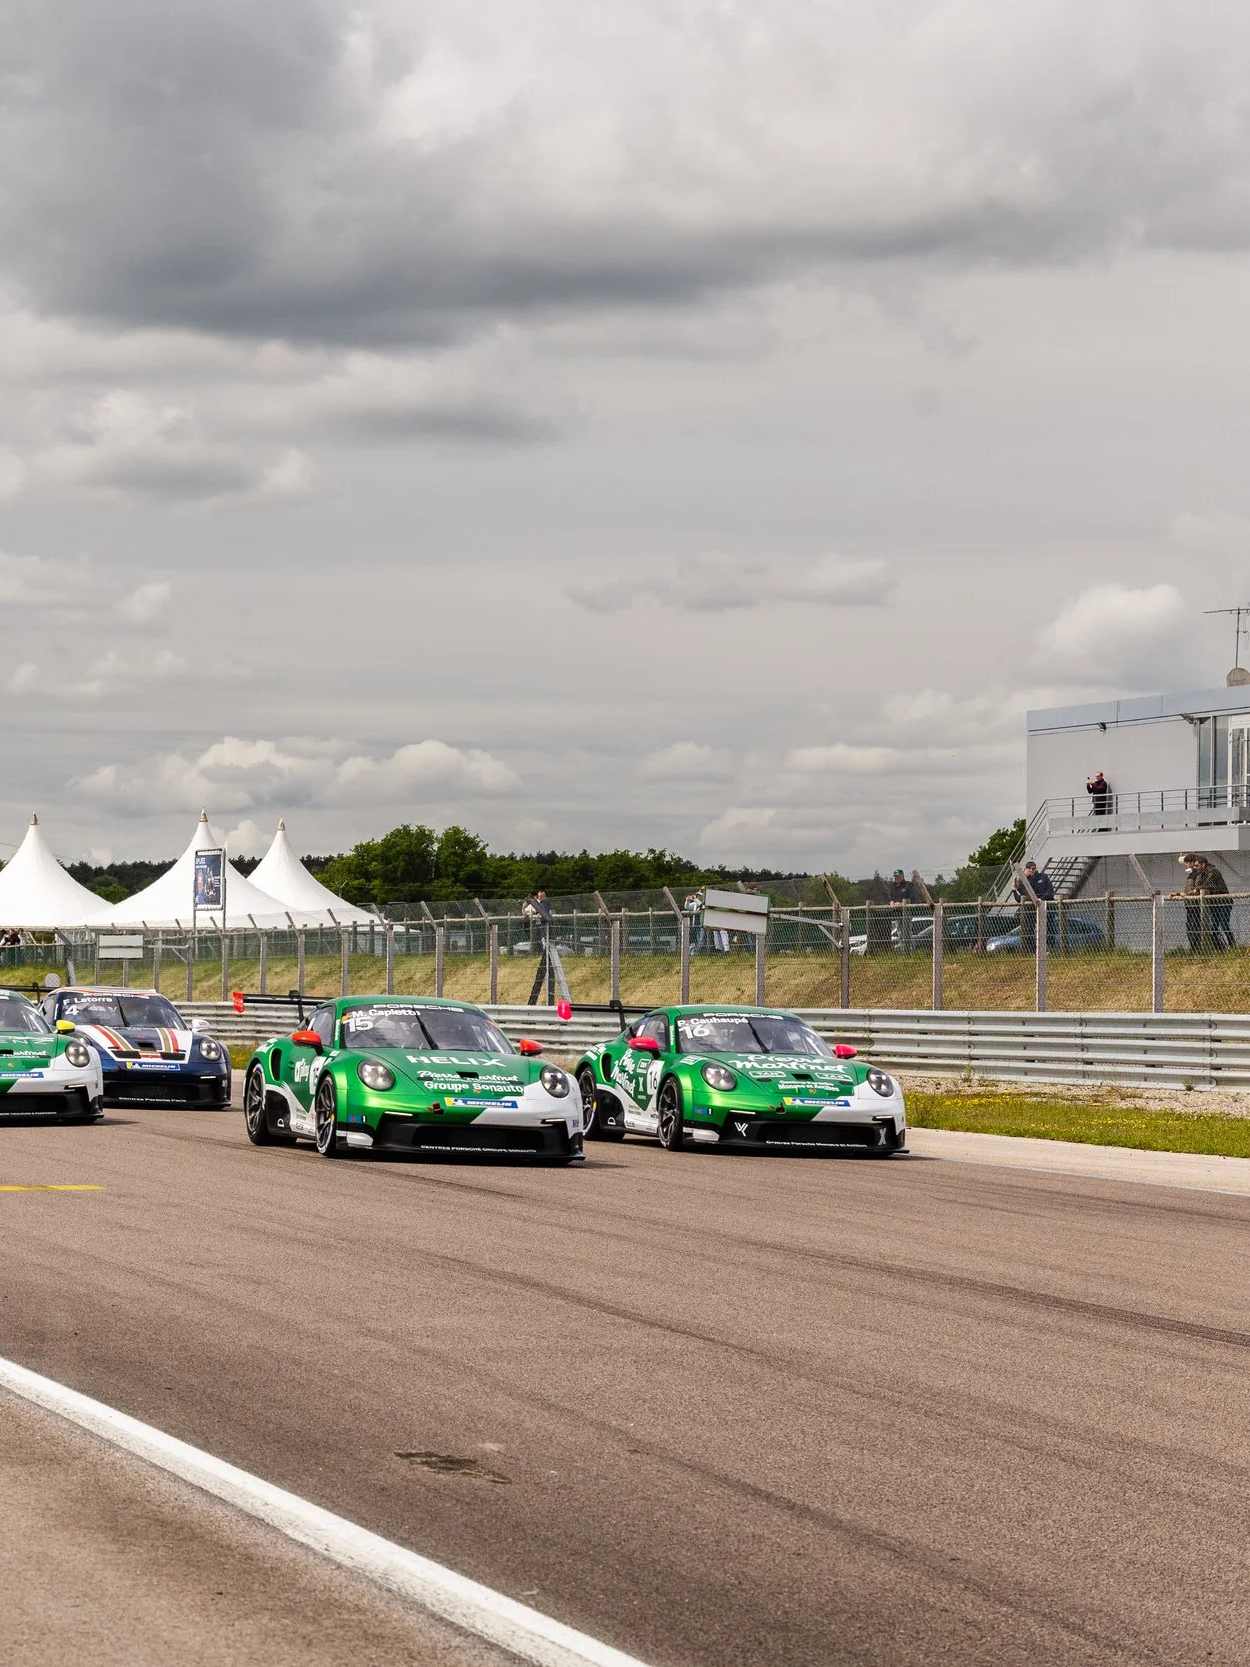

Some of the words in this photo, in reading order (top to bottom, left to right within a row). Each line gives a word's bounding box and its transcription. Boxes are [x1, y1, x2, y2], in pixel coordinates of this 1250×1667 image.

[74, 996, 113, 1004] Latorre
[65, 1005, 80, 1015] 4
[352, 1010, 367, 1018] M.
[373, 1004, 464, 1013] PORSCHE
[703, 1012, 784, 1020] PORSCHE
[343, 1017, 374, 1033] 15
[677, 1019, 688, 1028] P.
[690, 1017, 749, 1025] Cauhaupé
[678, 1026, 710, 1039] 16
[405, 1055, 507, 1067] HELIX
[737, 1053, 829, 1064] Pierre
[728, 1060, 848, 1073] Martinet
[417, 1070, 461, 1079] Pierre
[650, 1071, 657, 1089] 16
[424, 1080, 470, 1093] Groupe
[472, 1082, 524, 1093] Sonauto
